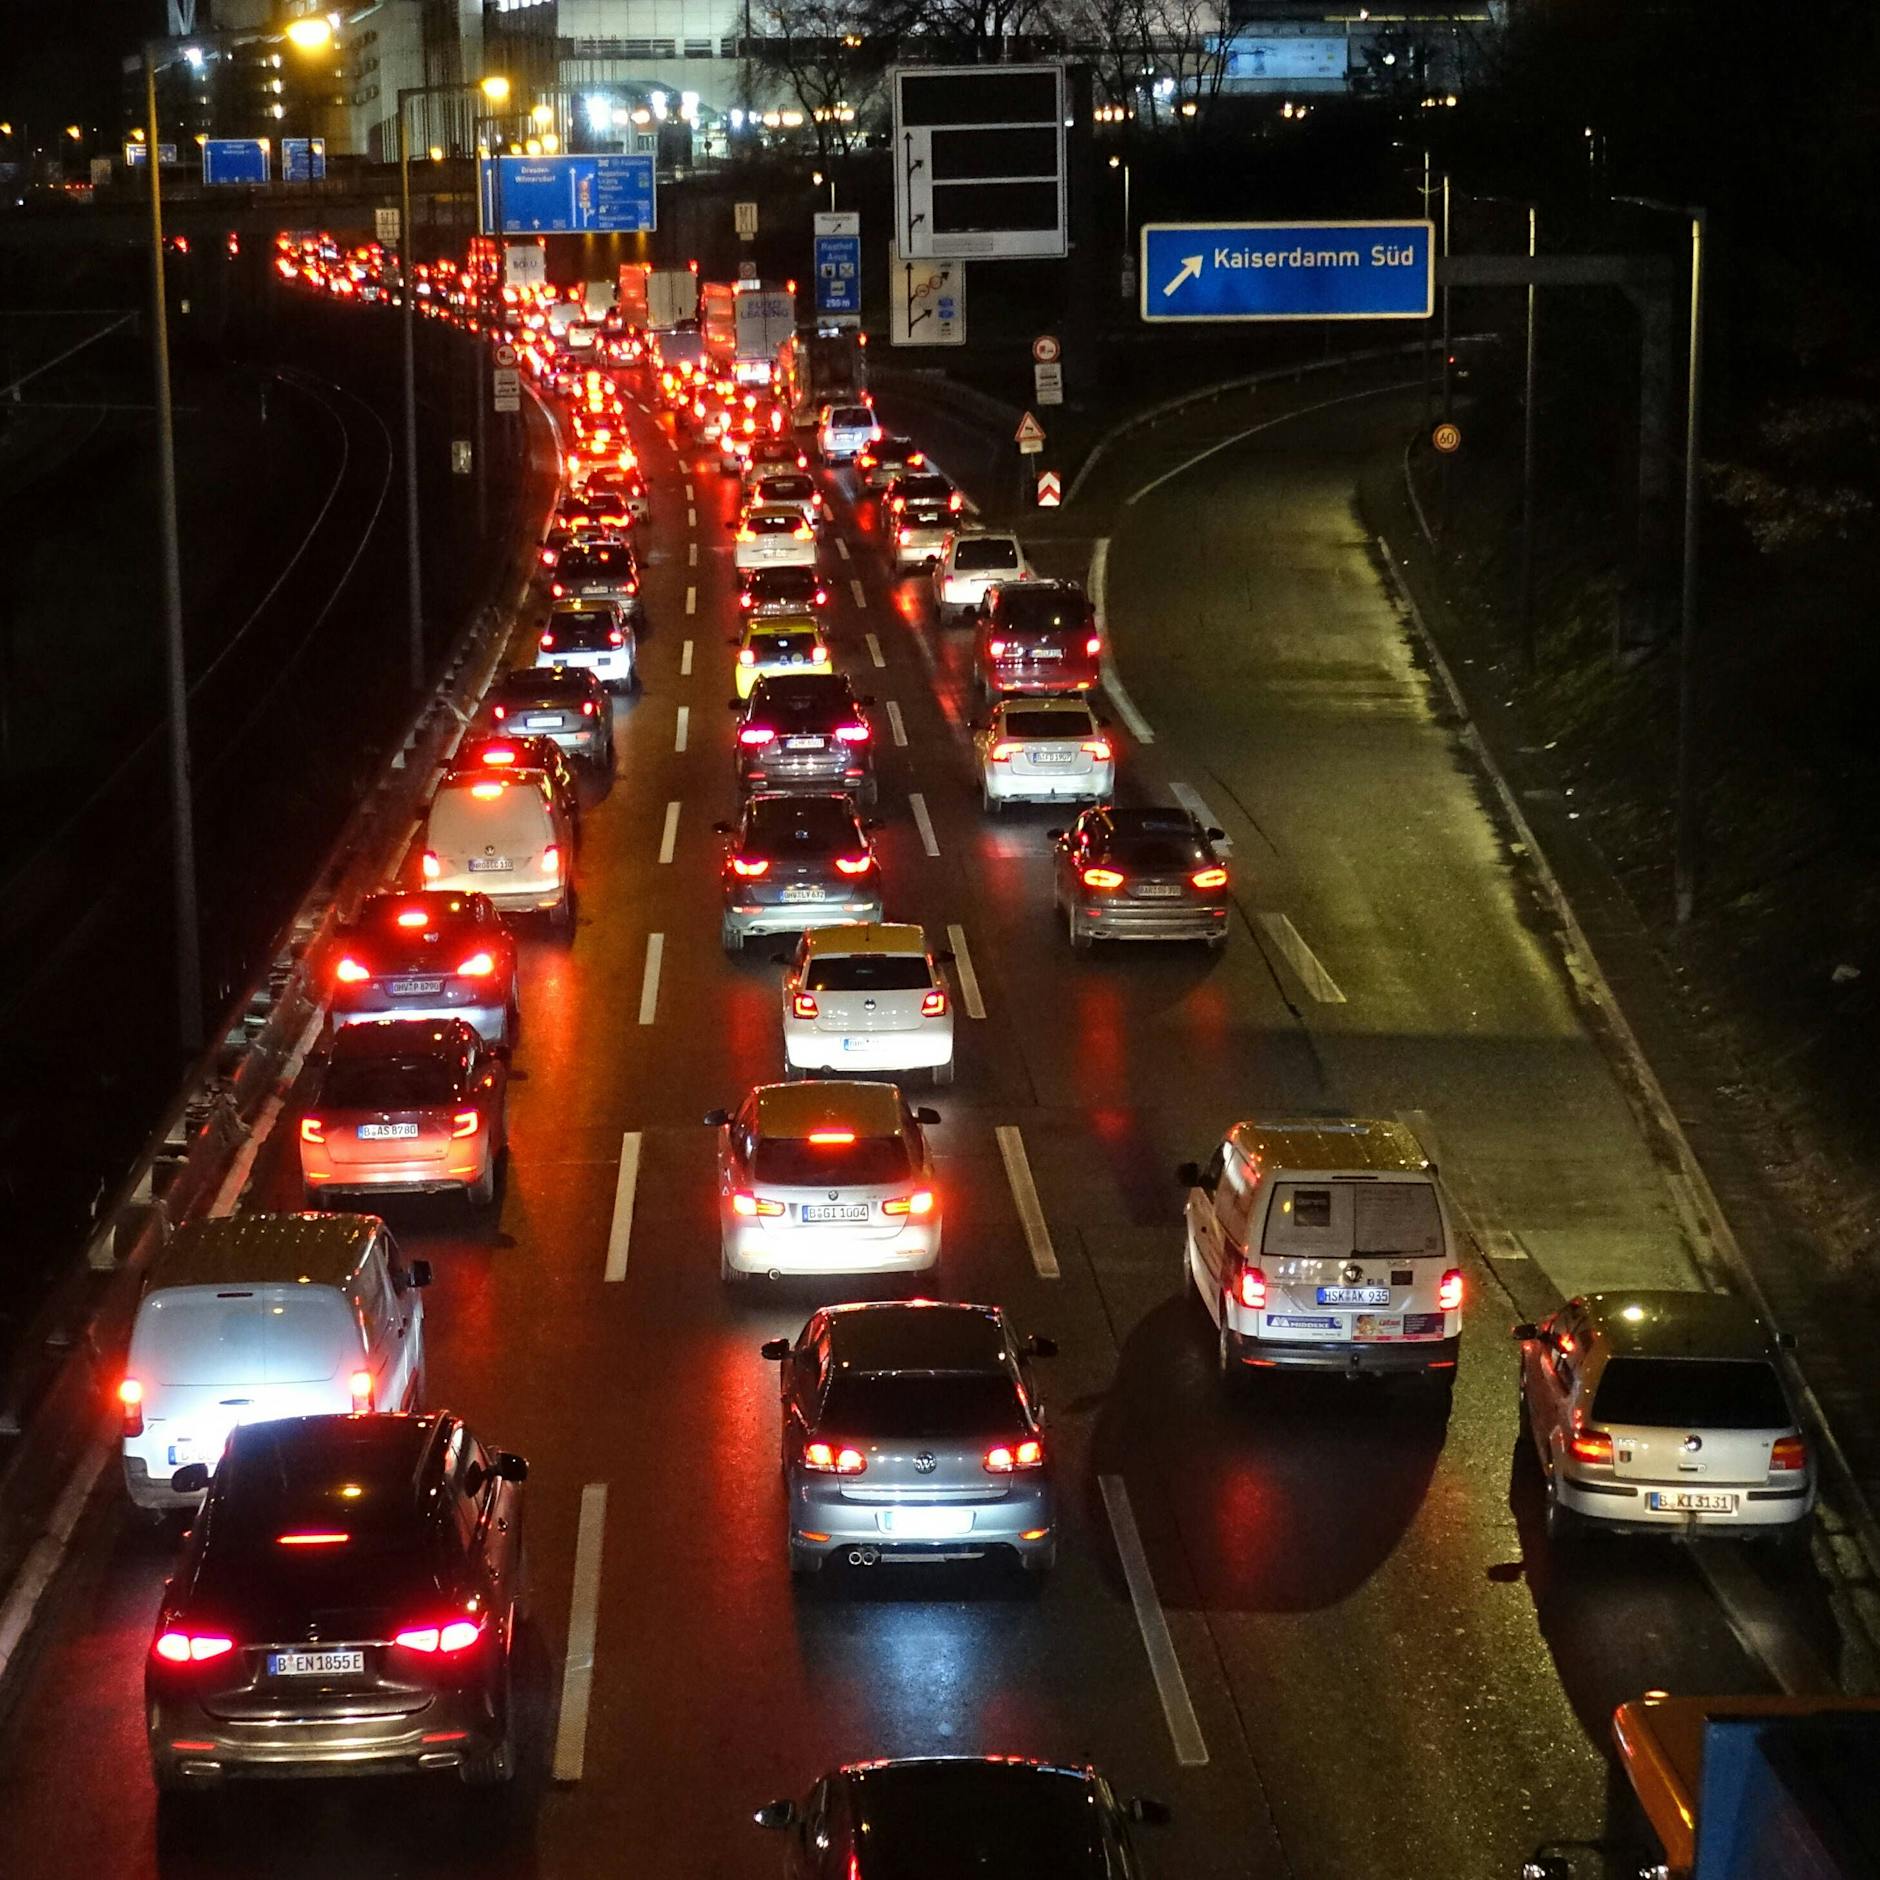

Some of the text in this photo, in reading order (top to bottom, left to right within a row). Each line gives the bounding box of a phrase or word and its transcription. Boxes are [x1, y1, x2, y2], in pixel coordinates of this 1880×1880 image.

[1213, 245, 1414, 269] Kaiserdamm Süd
[1440, 432, 1454, 445] 60
[364, 1125, 417, 1137] B AS 8780
[810, 1206, 866, 1218] B GI 1004
[1325, 1290, 1388, 1302] HSK AK 935
[1660, 1494, 1728, 1509] B KI 3131
[278, 1657, 286, 1672] B
[296, 1656, 314, 1671] EN
